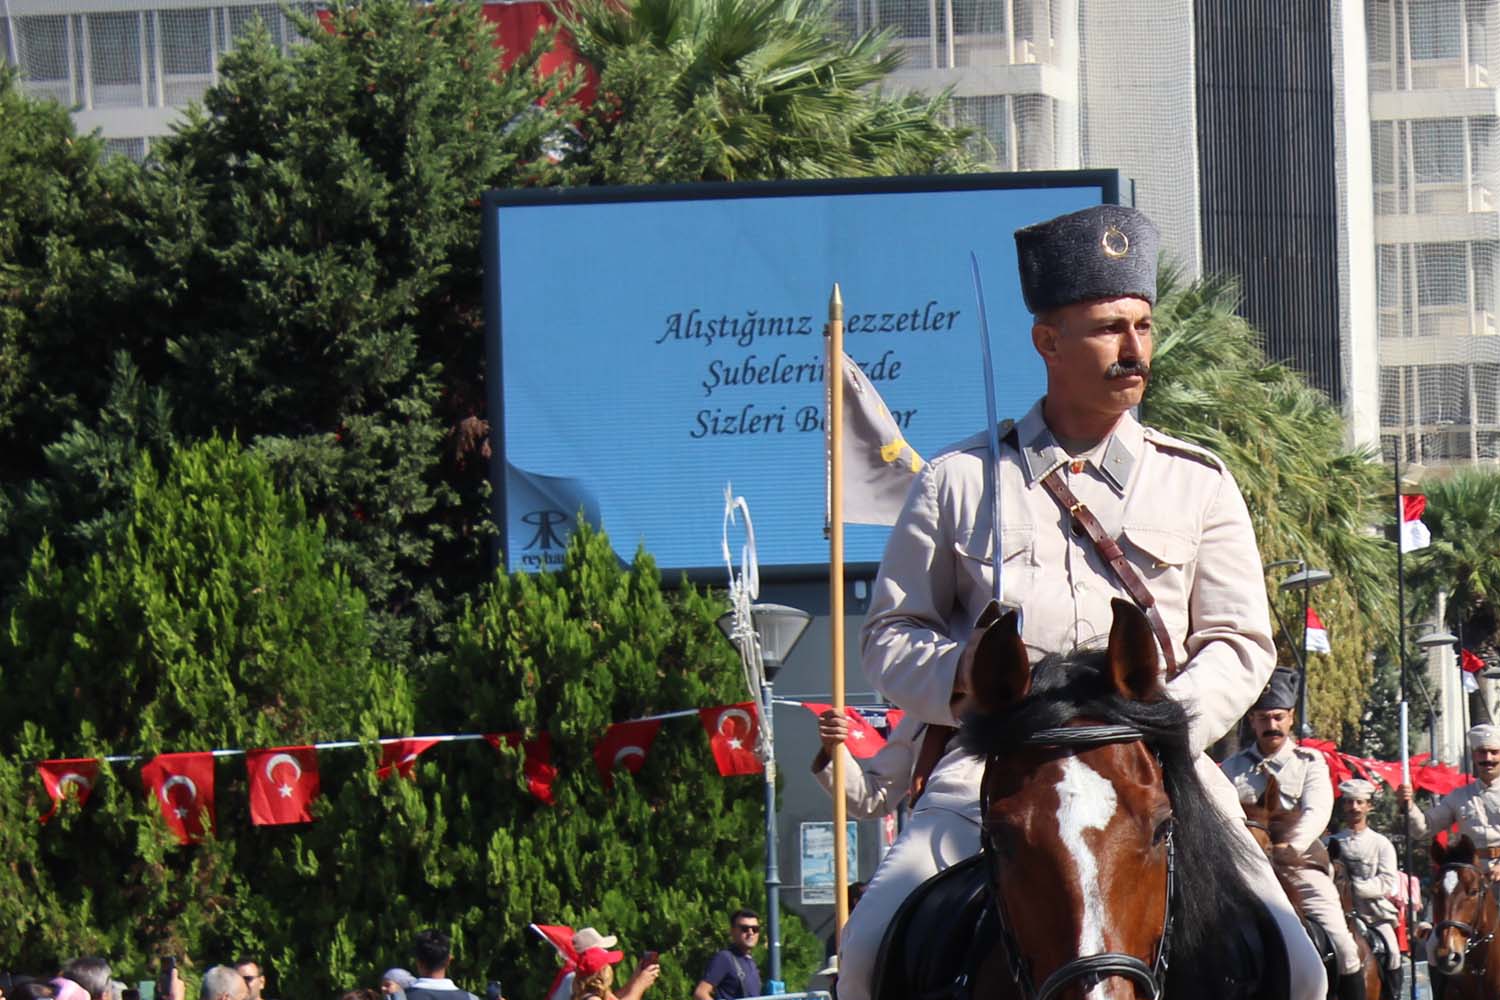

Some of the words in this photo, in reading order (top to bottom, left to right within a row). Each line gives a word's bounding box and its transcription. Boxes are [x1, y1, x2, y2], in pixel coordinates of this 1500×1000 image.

[656, 309, 812, 347] Alıştığınız
[702, 350, 902, 396] Şubelerizde
[690, 405, 786, 439] Sizleri
